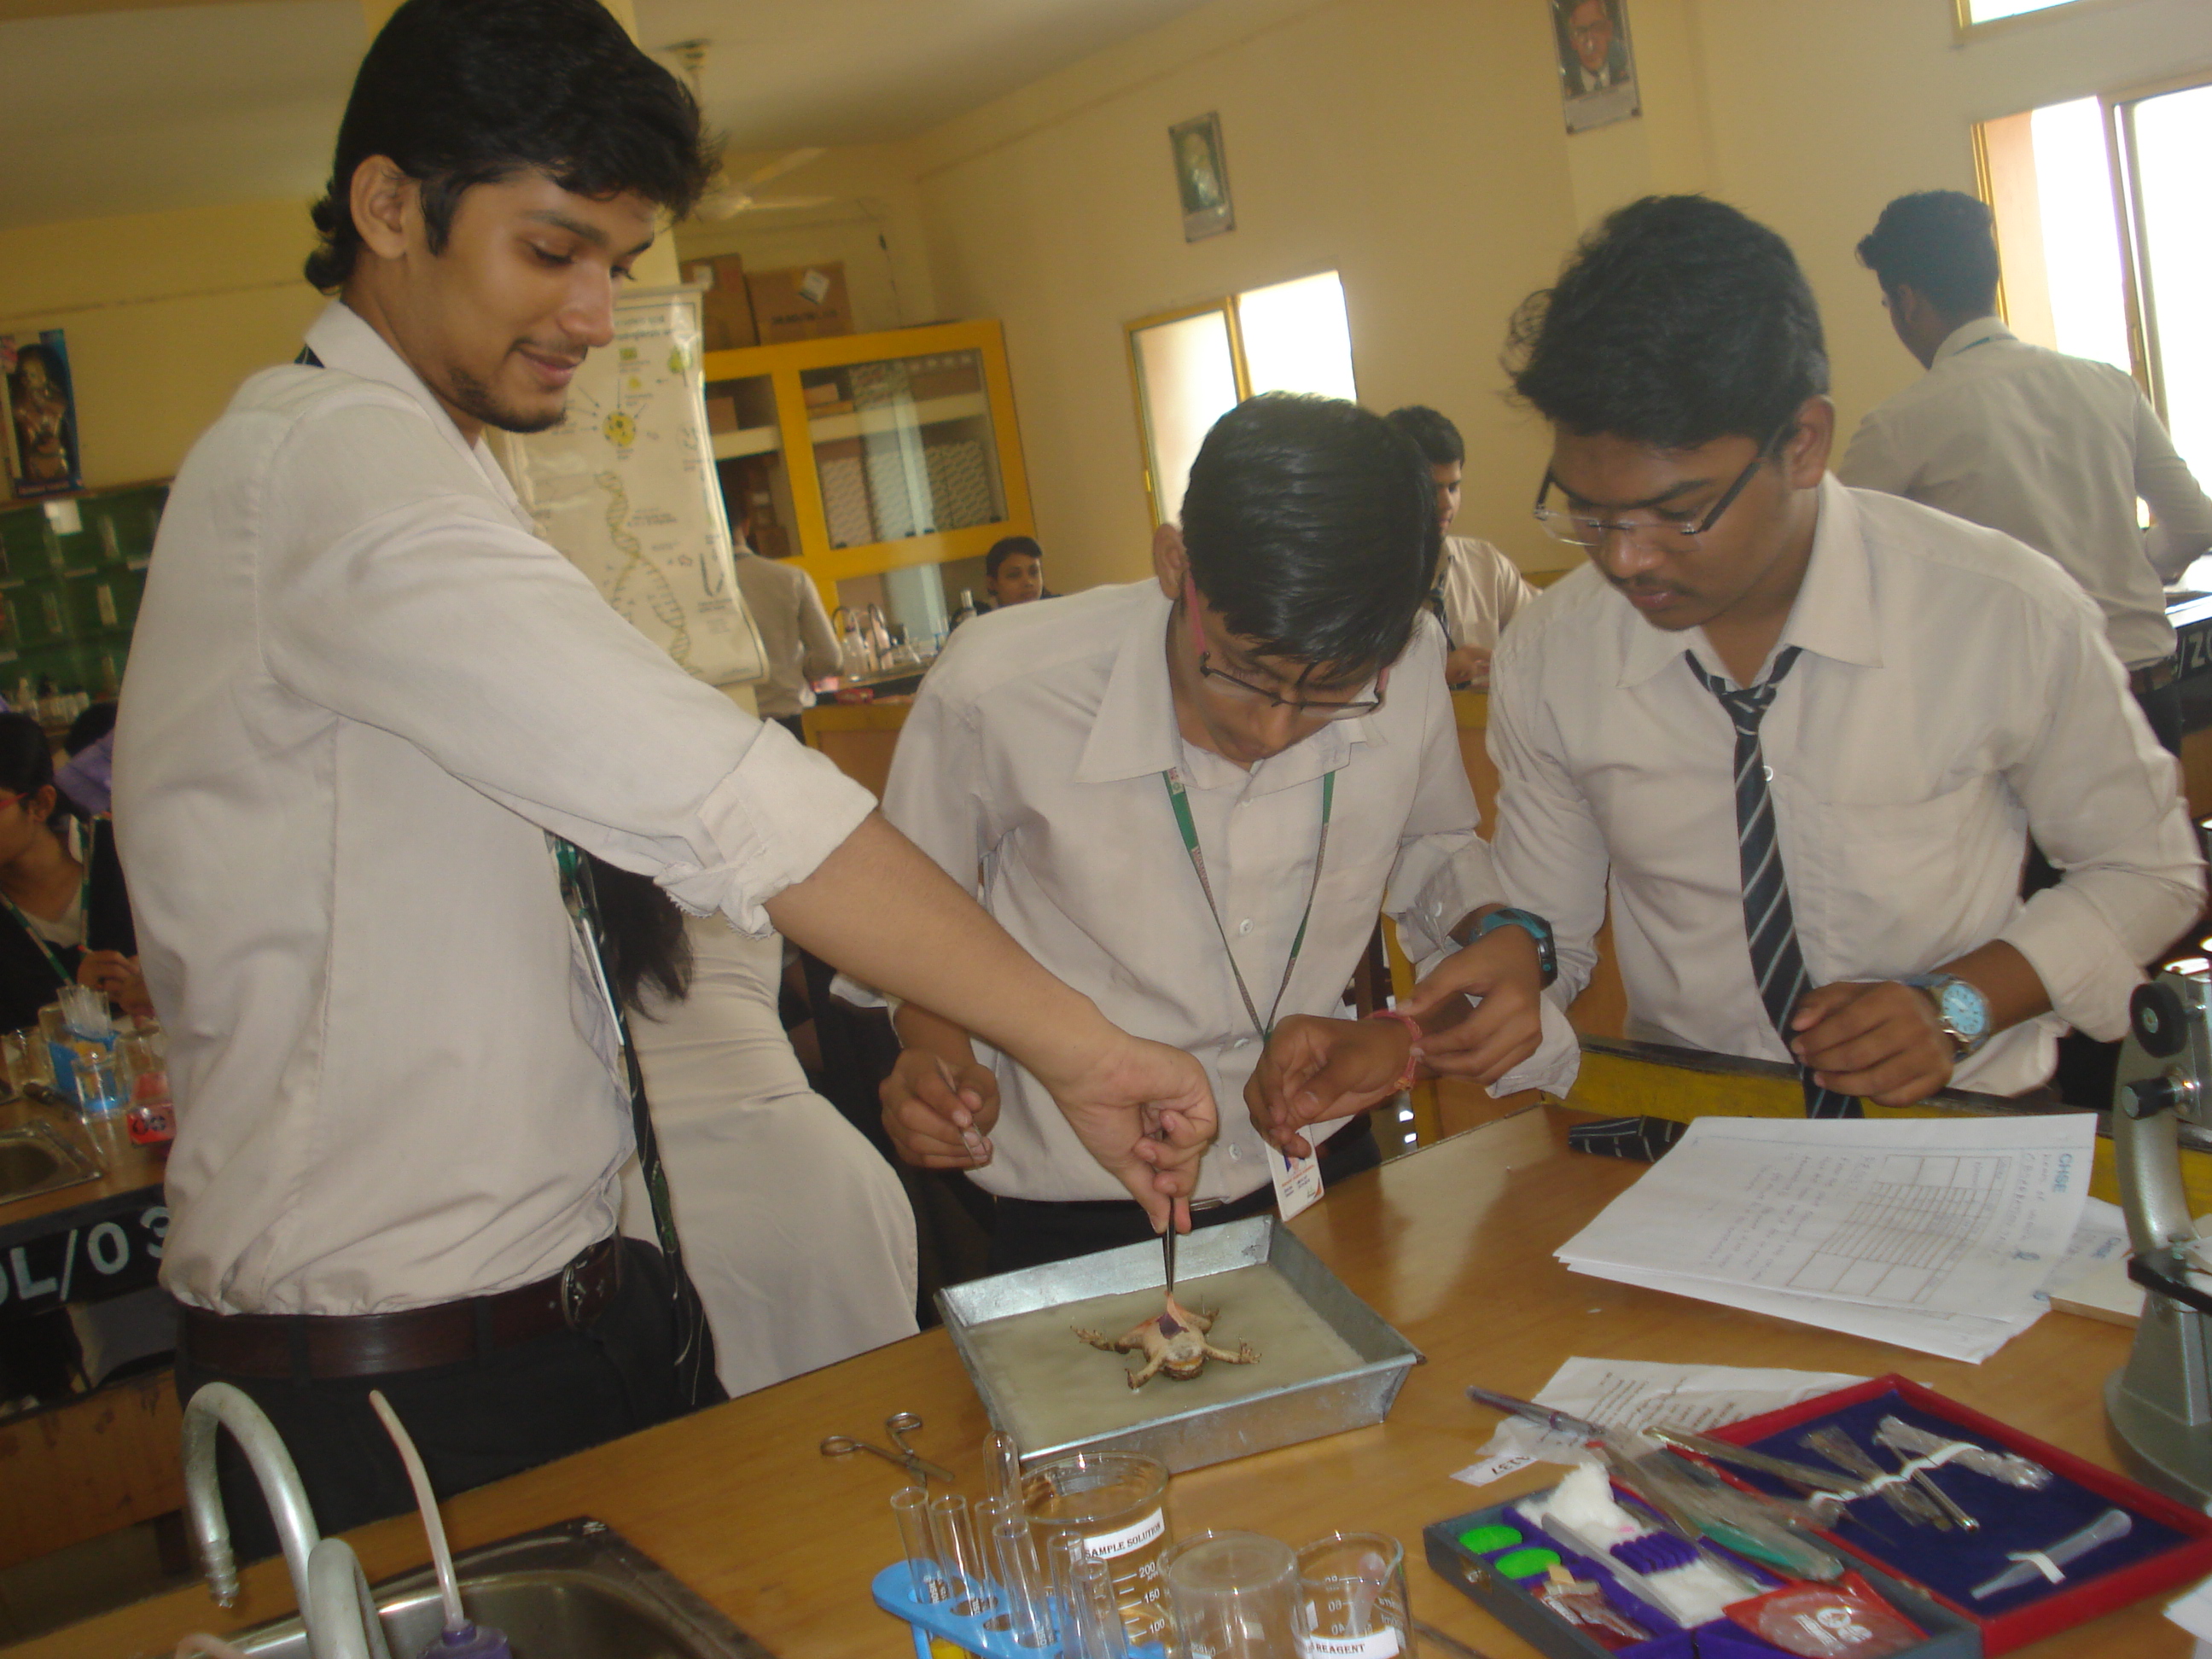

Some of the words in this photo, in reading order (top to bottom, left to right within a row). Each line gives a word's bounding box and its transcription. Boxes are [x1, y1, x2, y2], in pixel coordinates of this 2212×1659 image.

[1085, 1541, 1126, 1560] SAMPLE
[1126, 1522, 1161, 1547] SOLUTION
[1138, 1561, 1156, 1578] 200
[1144, 1587, 1161, 1604] 150
[1149, 1618, 1166, 1634] 100
[1315, 1642, 1366, 1655] REAGENT
